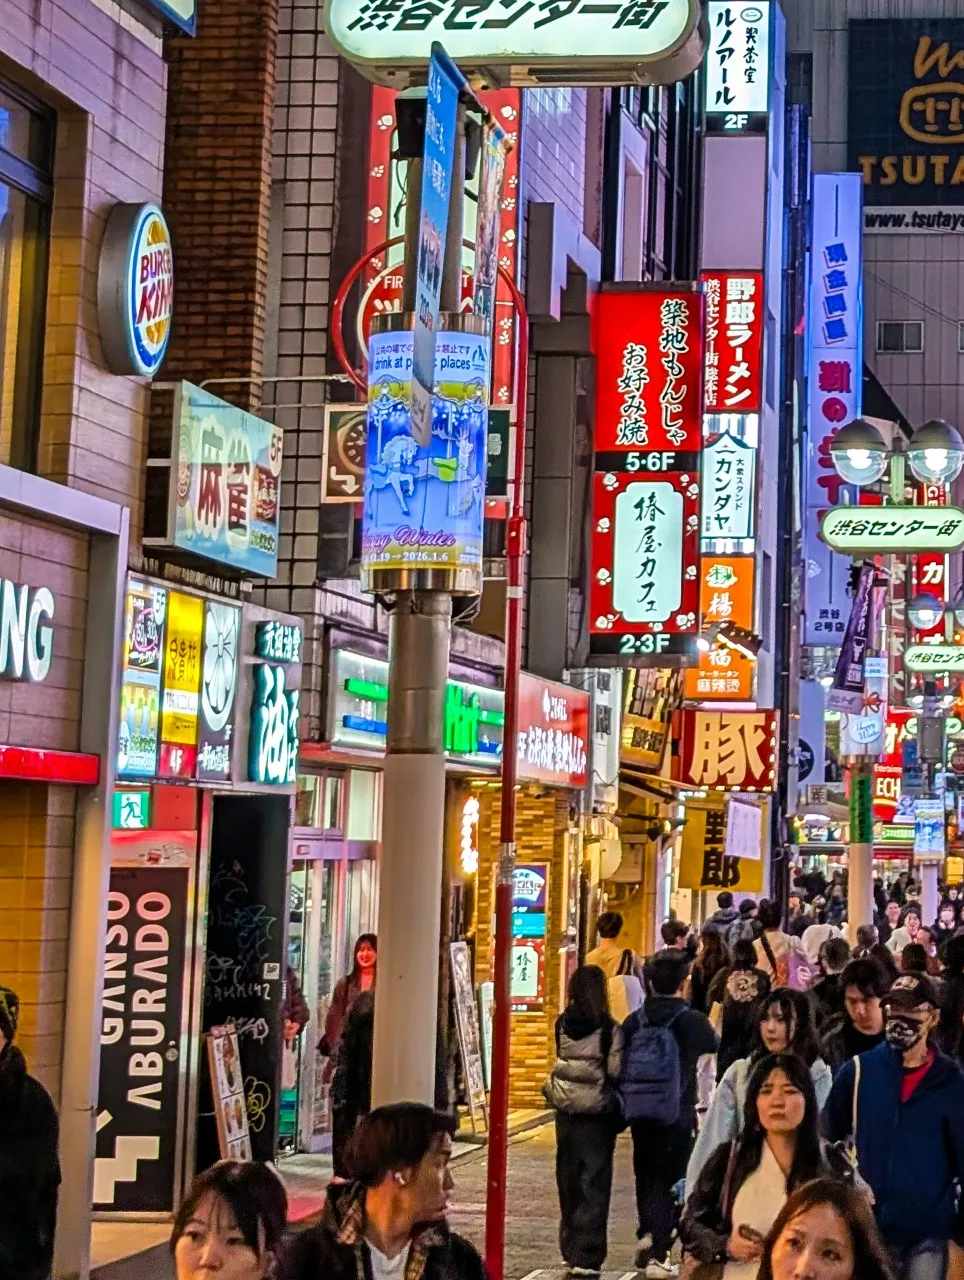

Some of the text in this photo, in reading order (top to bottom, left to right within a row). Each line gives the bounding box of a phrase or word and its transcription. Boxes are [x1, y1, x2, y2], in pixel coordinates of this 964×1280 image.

[714, 8, 737, 105] ルノアール
[741, 26, 760, 84] 喫茶室
[724, 113, 748, 130] 2F
[440, 356, 471, 370] places
[726, 277, 756, 406] 野郎ラーメン
[617, 343, 650, 447] お好み焼
[659, 298, 690, 447] 築地もんじゃ
[270, 433, 283, 464] 5F
[198, 426, 251, 532] 麻雀
[714, 458, 733, 530] カンダヤ
[735, 458, 745, 511] 大衆スタンド
[394, 525, 457, 547] Winter
[633, 491, 667, 613] 椿屋カフェ
[829, 517, 962, 540] 渋谷センター街
[403, 551, 449, 562] 2026.1.6
[814, 621, 846, 633] 2号店
[819, 608, 841, 619] 渋谷
[169, 749, 184, 772] 4F
[688, 712, 767, 788] 豚
[127, 891, 172, 1110] ABURADO
